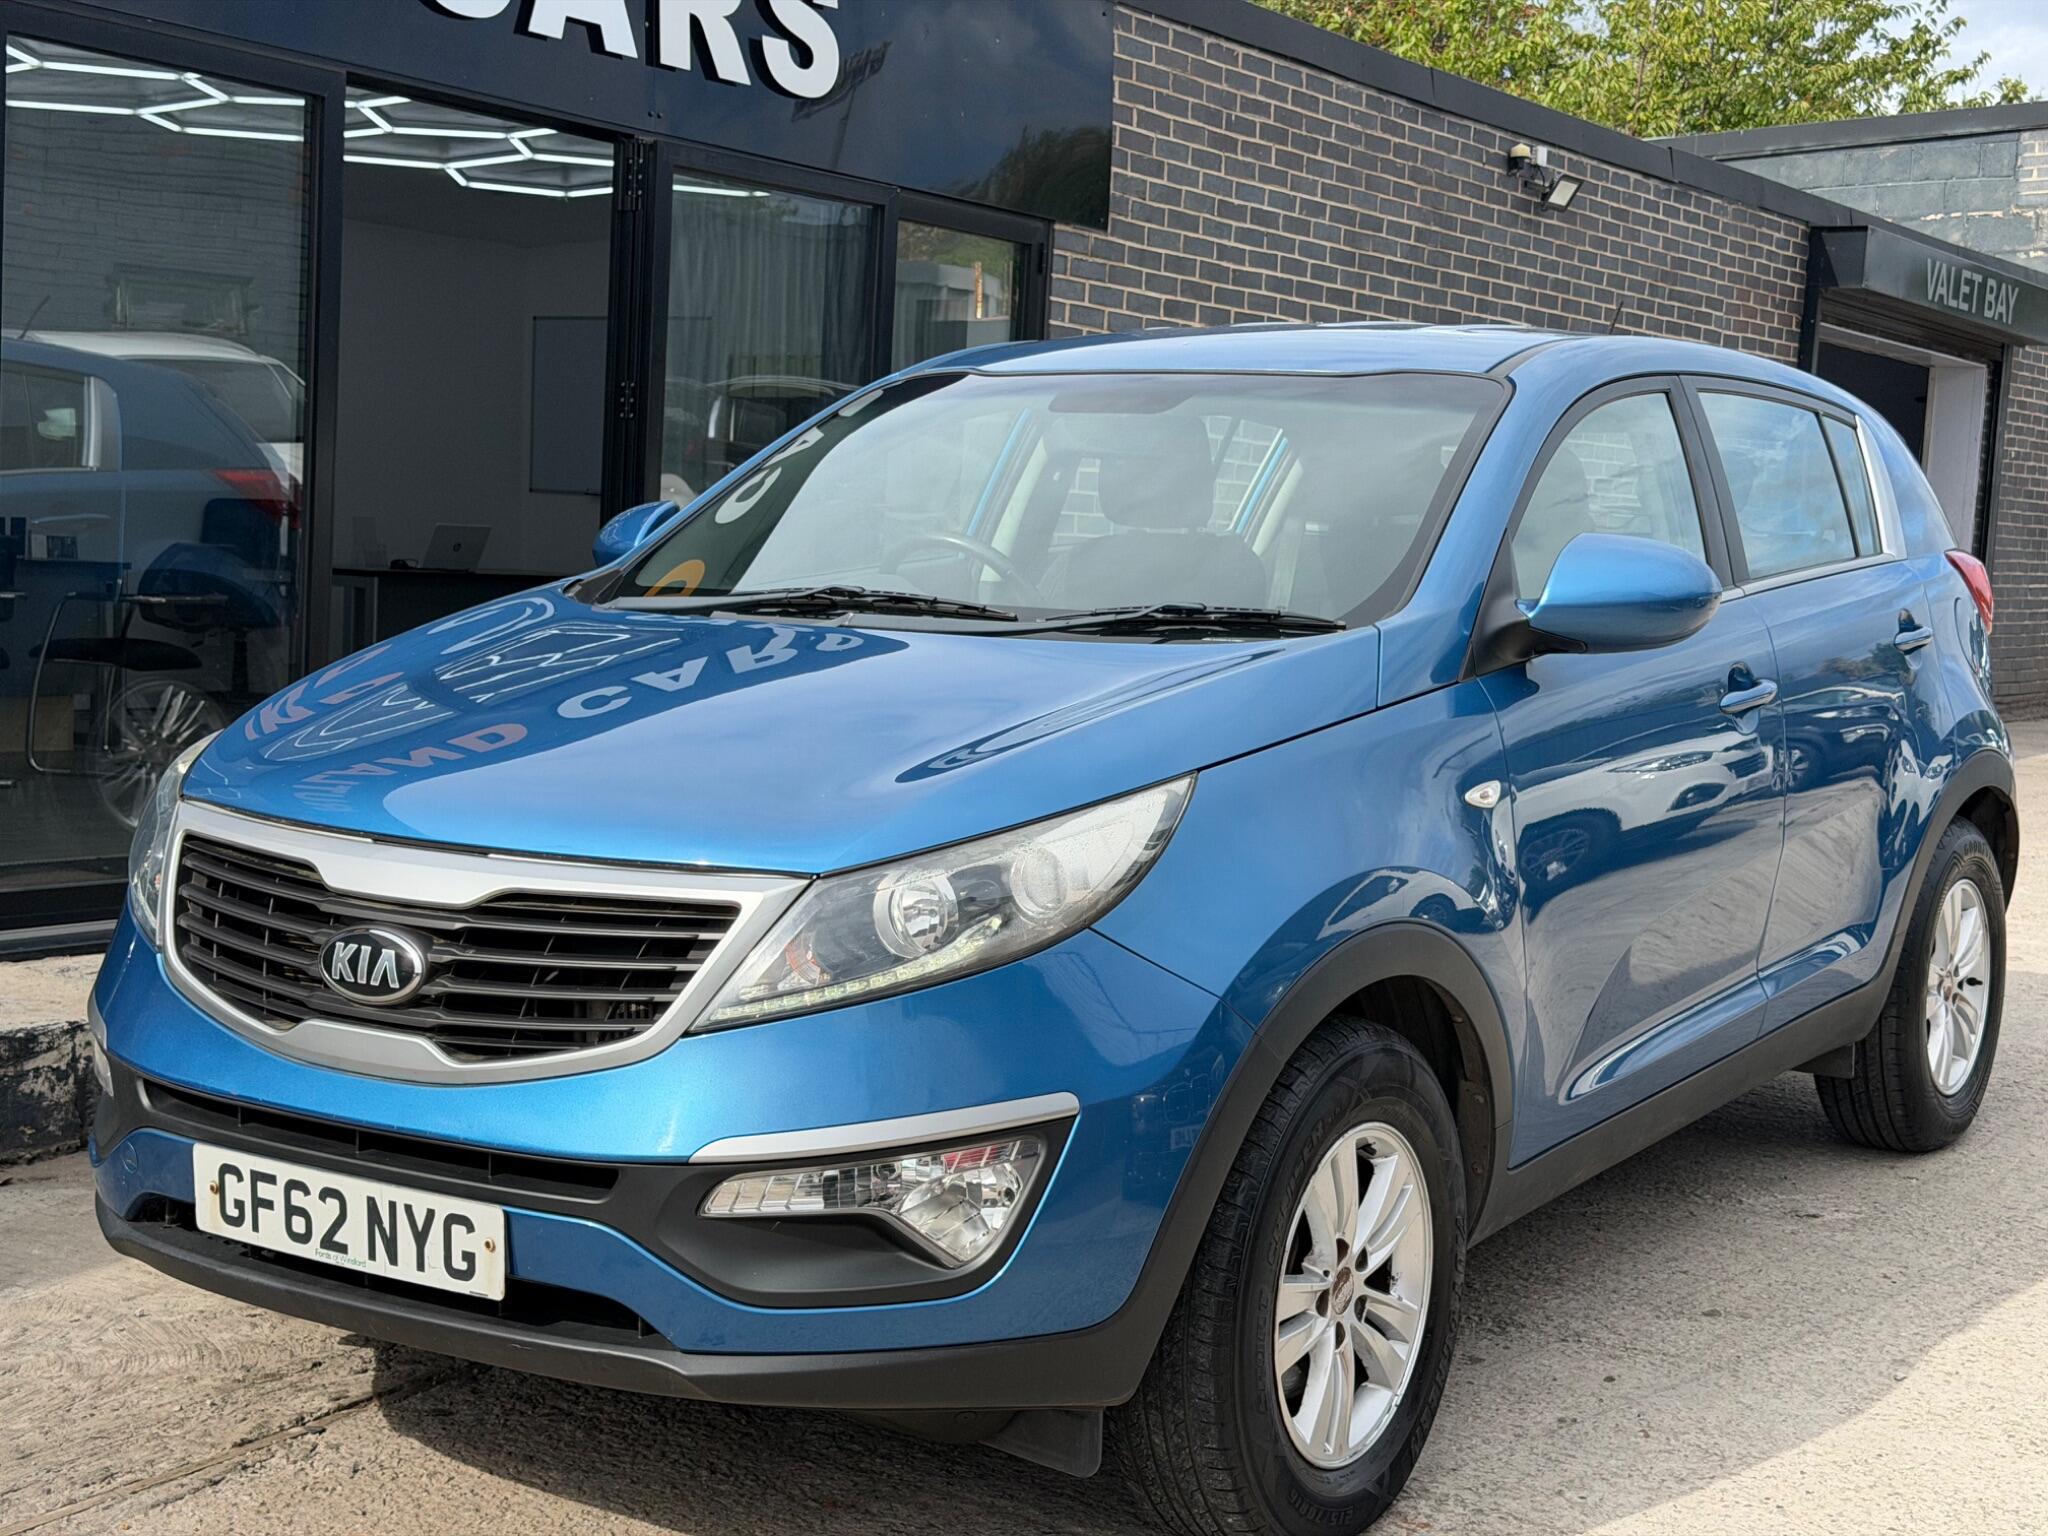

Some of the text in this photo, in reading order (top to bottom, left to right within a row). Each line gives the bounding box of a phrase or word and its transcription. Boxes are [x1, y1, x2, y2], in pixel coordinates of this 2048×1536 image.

[1927, 257, 2019, 325] VALET BAY
[331, 941, 400, 989] KIA
[218, 1162, 477, 1283] GF62 NYG
